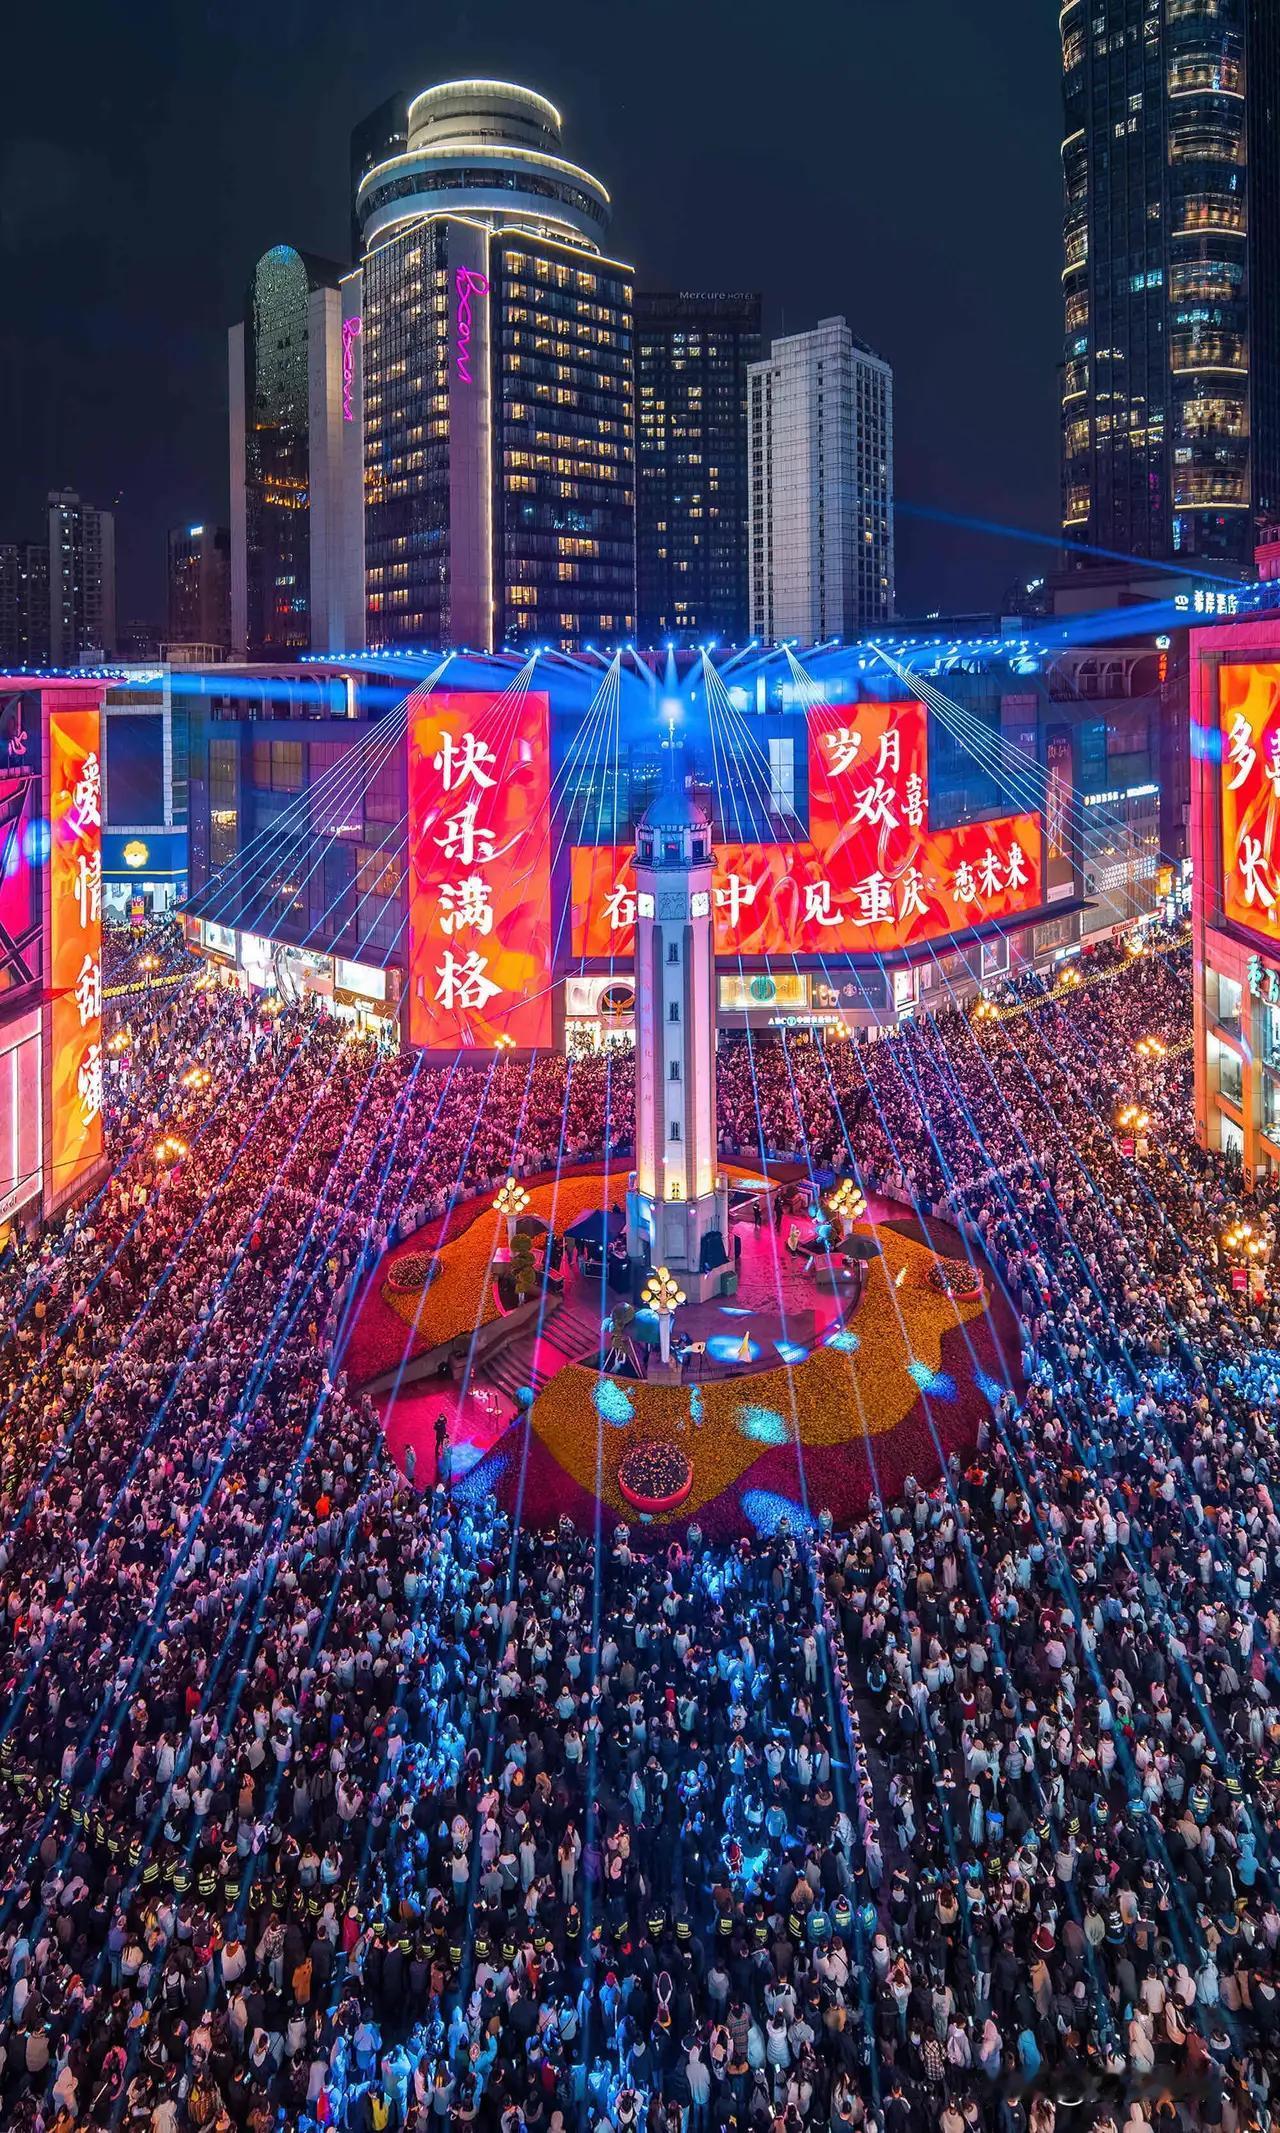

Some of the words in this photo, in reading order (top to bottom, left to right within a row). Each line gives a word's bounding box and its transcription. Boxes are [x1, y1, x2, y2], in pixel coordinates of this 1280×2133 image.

[679, 290, 726, 300] Mercure
[826, 727, 900, 777] 岁月
[850, 773, 929, 830] 欢喜
[433, 731, 503, 1010] 快乐满格
[953, 841, 1029, 903] 恋未来
